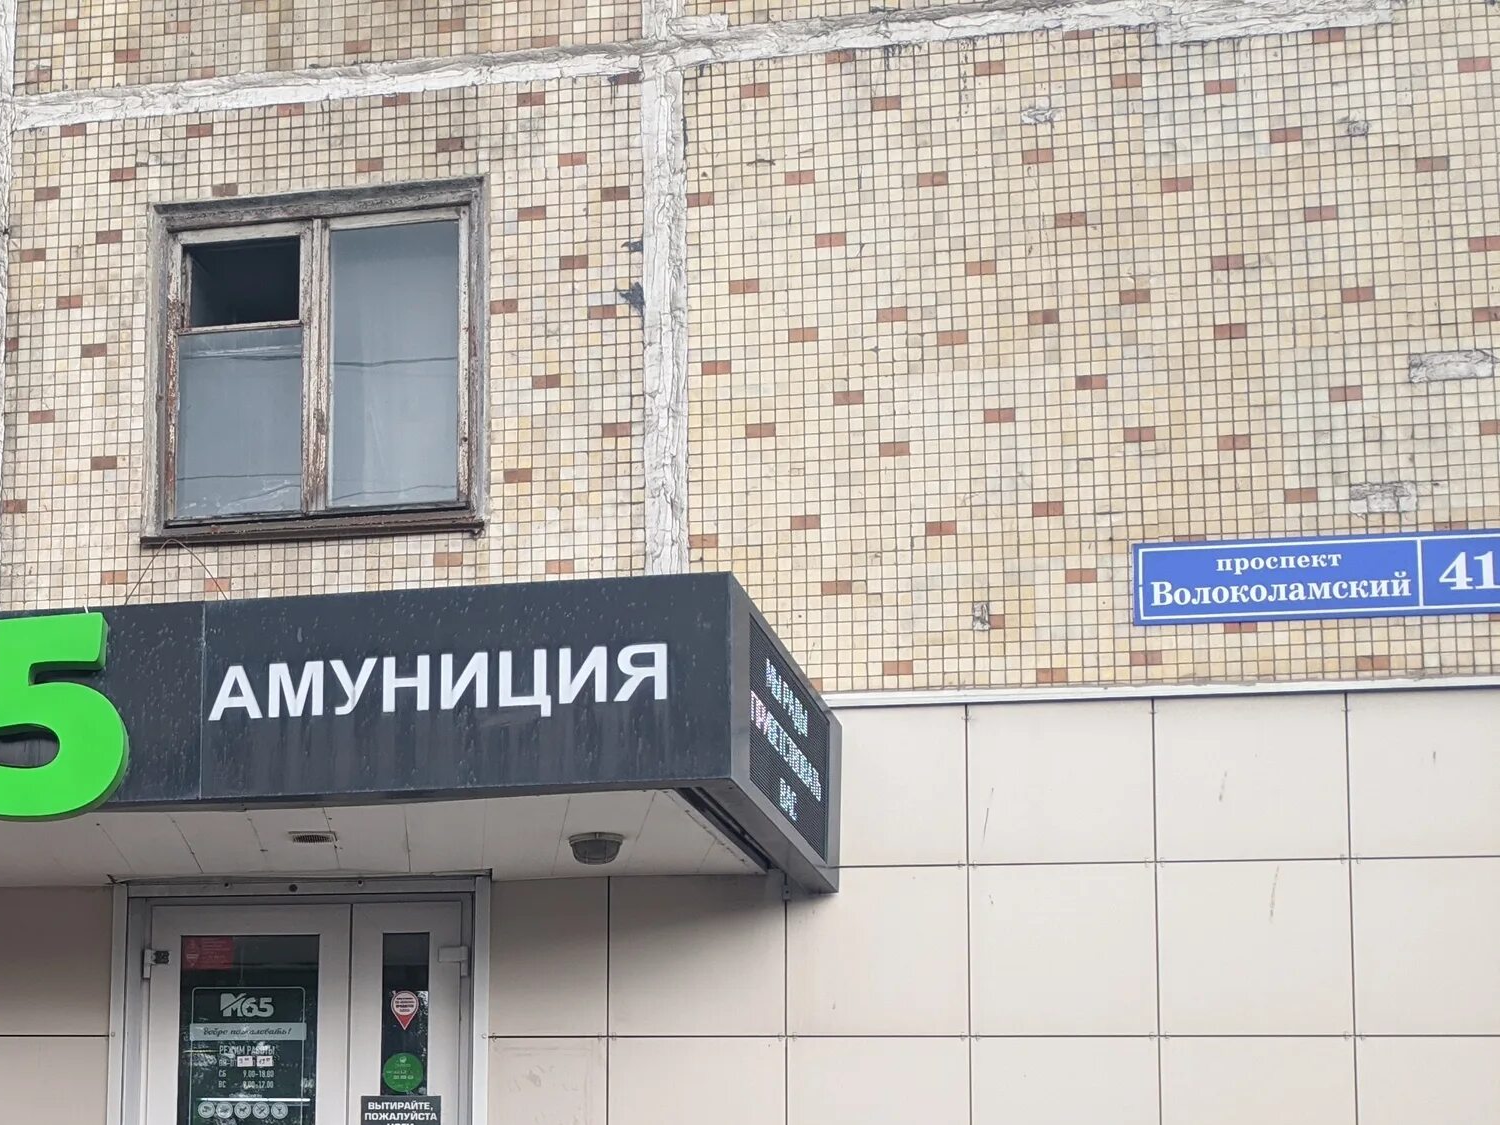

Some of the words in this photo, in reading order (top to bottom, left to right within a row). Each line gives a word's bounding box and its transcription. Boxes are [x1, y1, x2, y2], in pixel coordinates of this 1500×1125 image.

[1216, 553, 1342, 575] проспект
[1438, 551, 1500, 591] 41
[1150, 571, 1412, 606] Волоколамский
[208, 642, 669, 722] АМУНИЦИЯ
[779, 778, 797, 820] ВАС
[219, 1070, 226, 1078] СБ
[364, 1111, 438, 1121] ПОЖАЛУЙСТА
[368, 1101, 434, 1111] ВЫТИРАЙТЕ,
